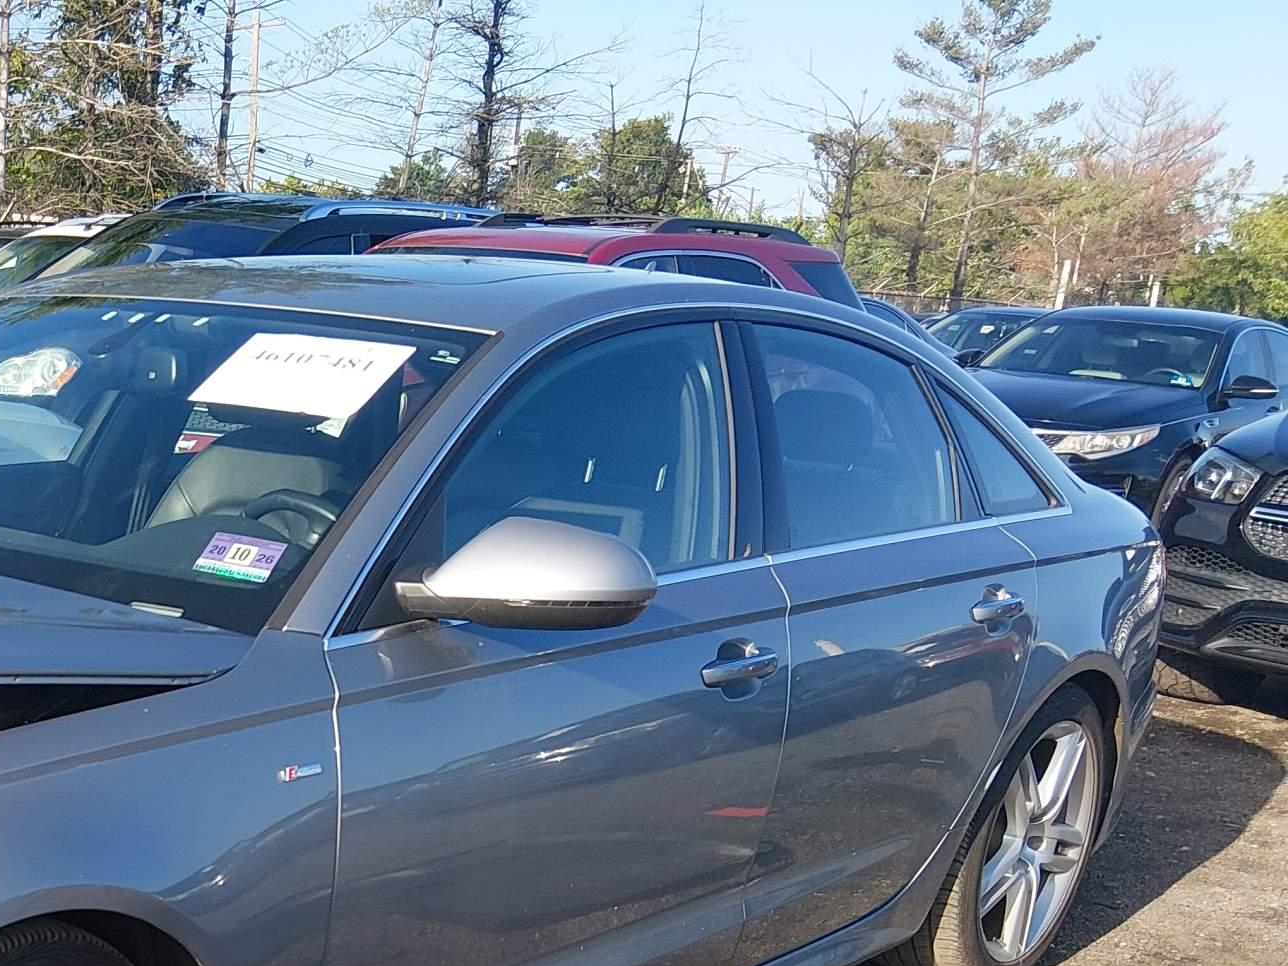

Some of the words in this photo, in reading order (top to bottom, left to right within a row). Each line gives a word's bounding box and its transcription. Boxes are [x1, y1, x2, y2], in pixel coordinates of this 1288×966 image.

[208, 544, 227, 557] 20
[228, 546, 252, 562] 10
[255, 553, 274, 565] 26
